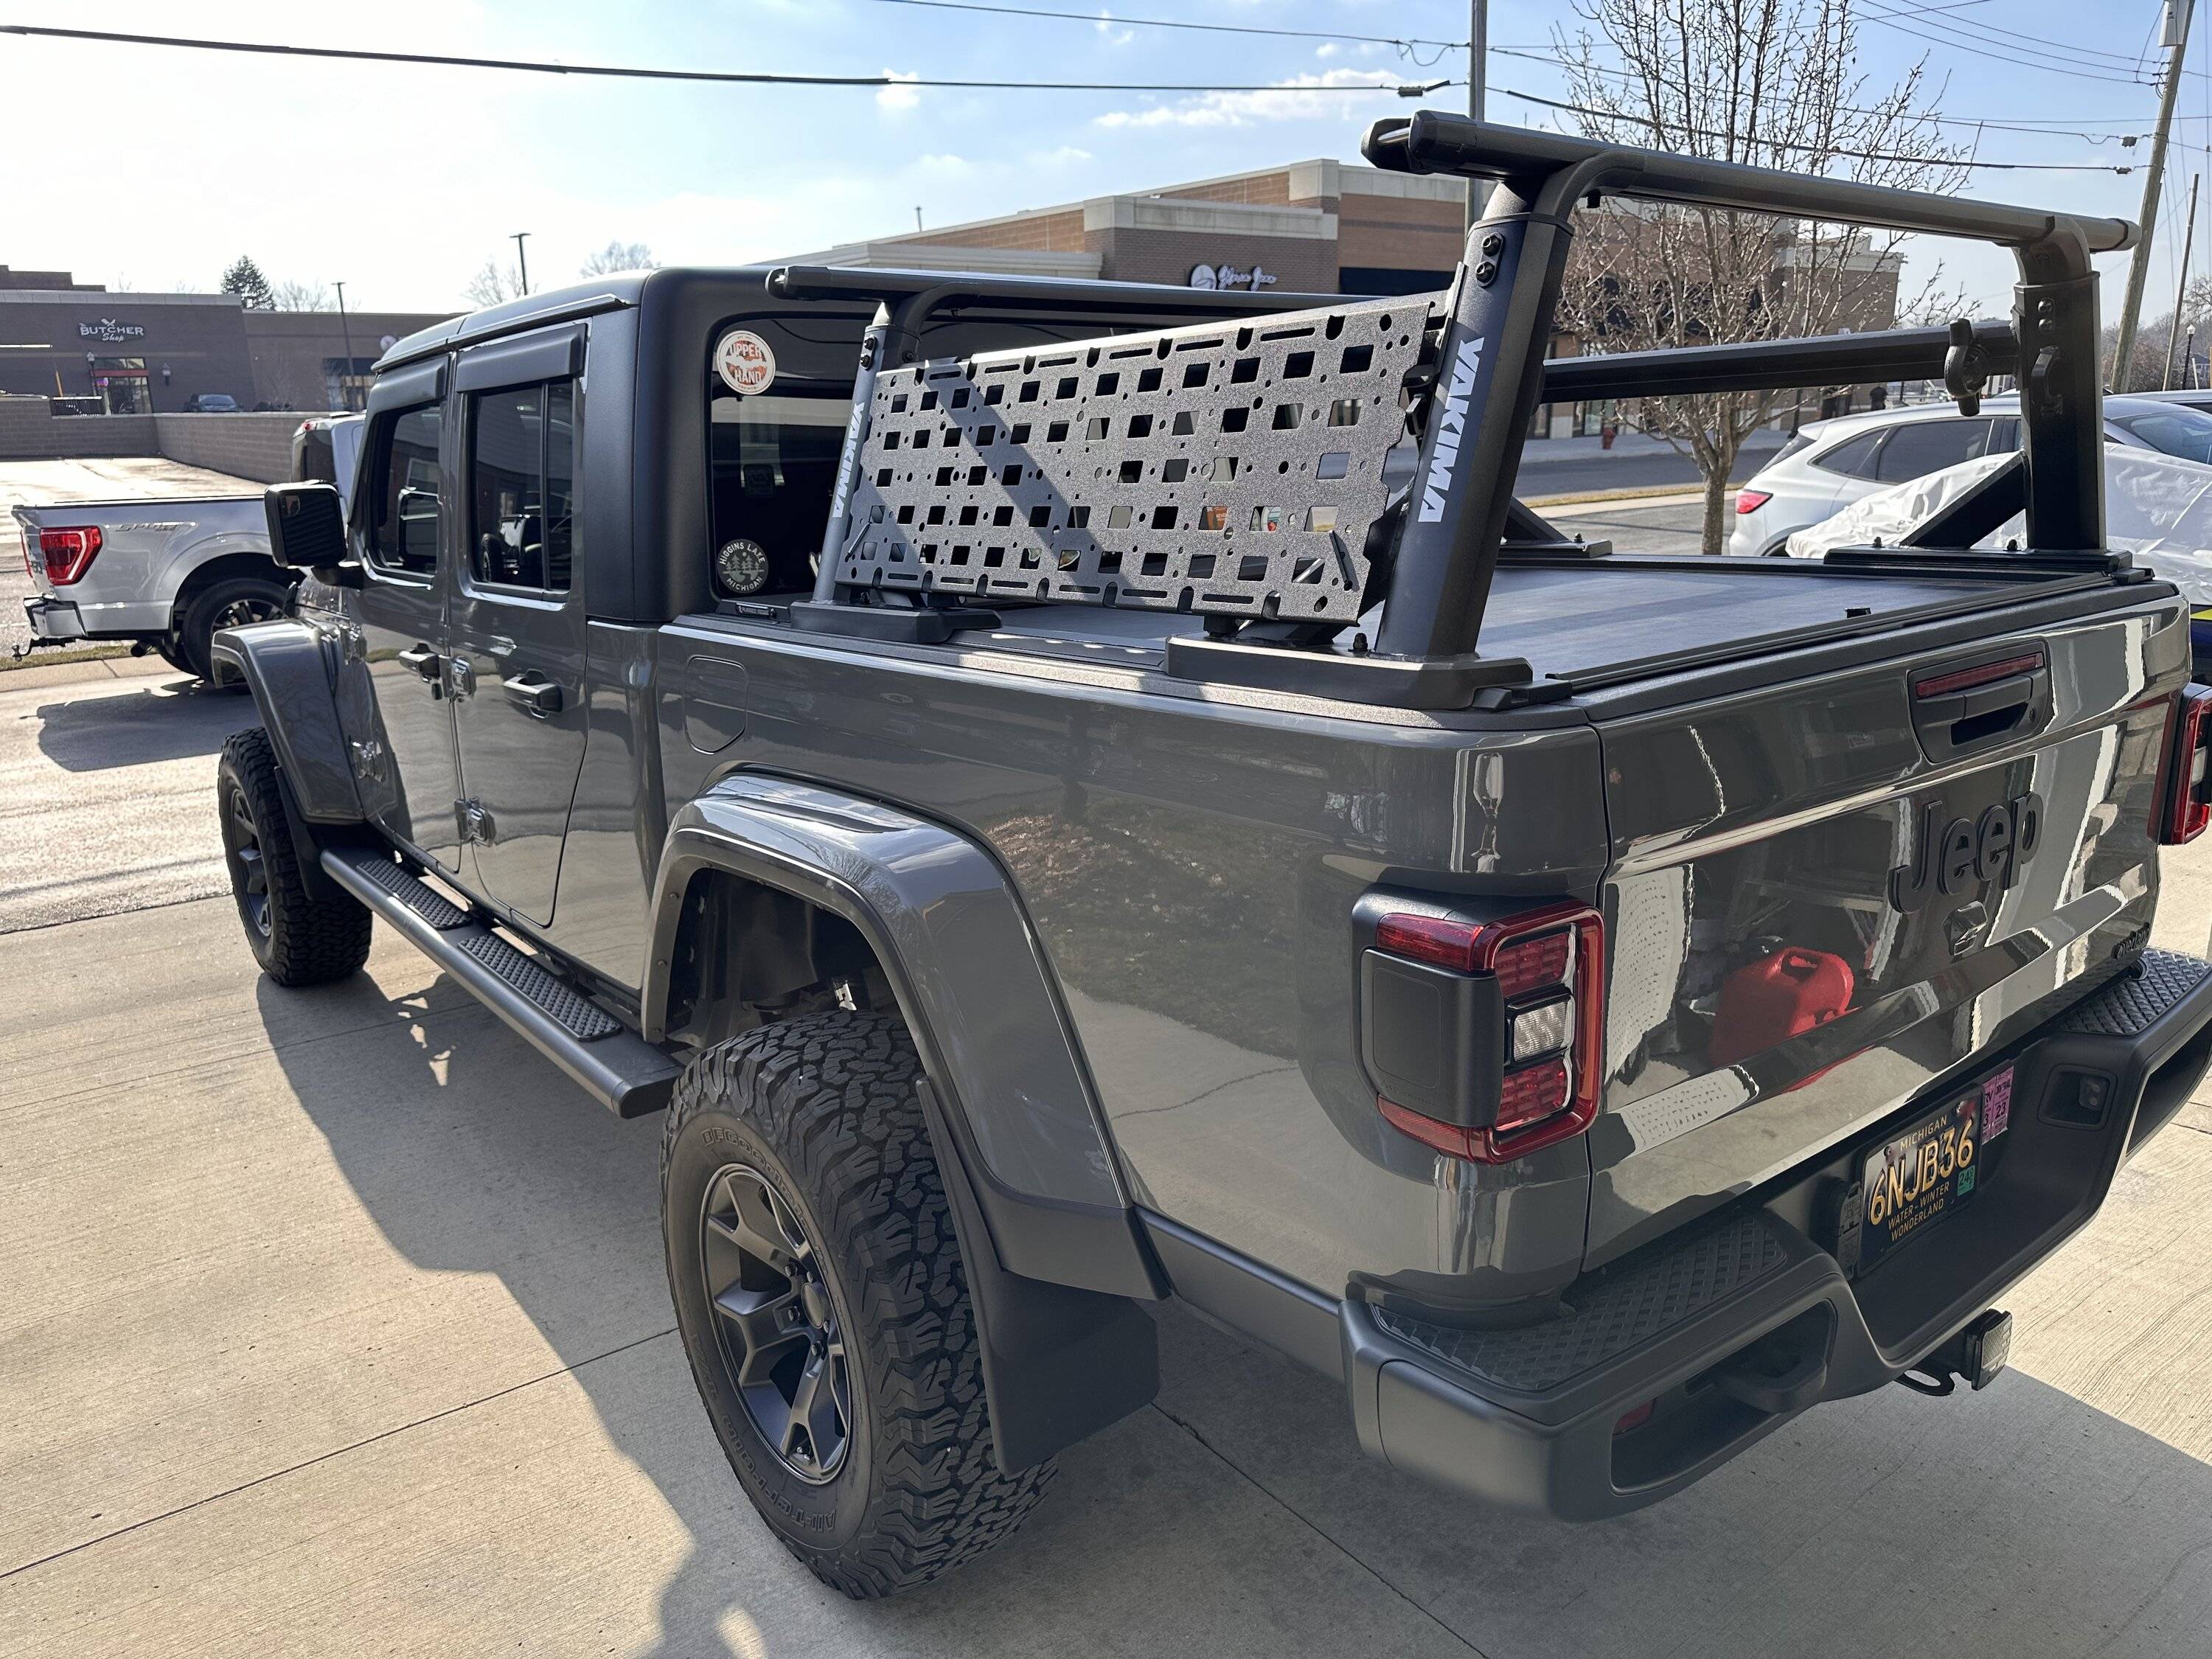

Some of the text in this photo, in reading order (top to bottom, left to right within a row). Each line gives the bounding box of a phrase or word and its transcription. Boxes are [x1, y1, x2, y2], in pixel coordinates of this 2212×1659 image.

[80, 326, 145, 336] BUTCHER
[102, 333, 125, 342] Shop
[730, 341, 762, 358] UPPER
[734, 368, 762, 383] HAND
[1417, 337, 1485, 523] YAKIMA
[832, 402, 865, 518] YAKIMA
[719, 542, 765, 566] HIGGINS LAKE
[726, 576, 762, 591] MICHIGAN
[1888, 791, 2044, 914] Jeep
[1899, 1115, 1947, 1152] MICHIGAN
[1868, 1119, 1975, 1225] 6NJB36
[1891, 1198, 1944, 1242] WONDERLAND
